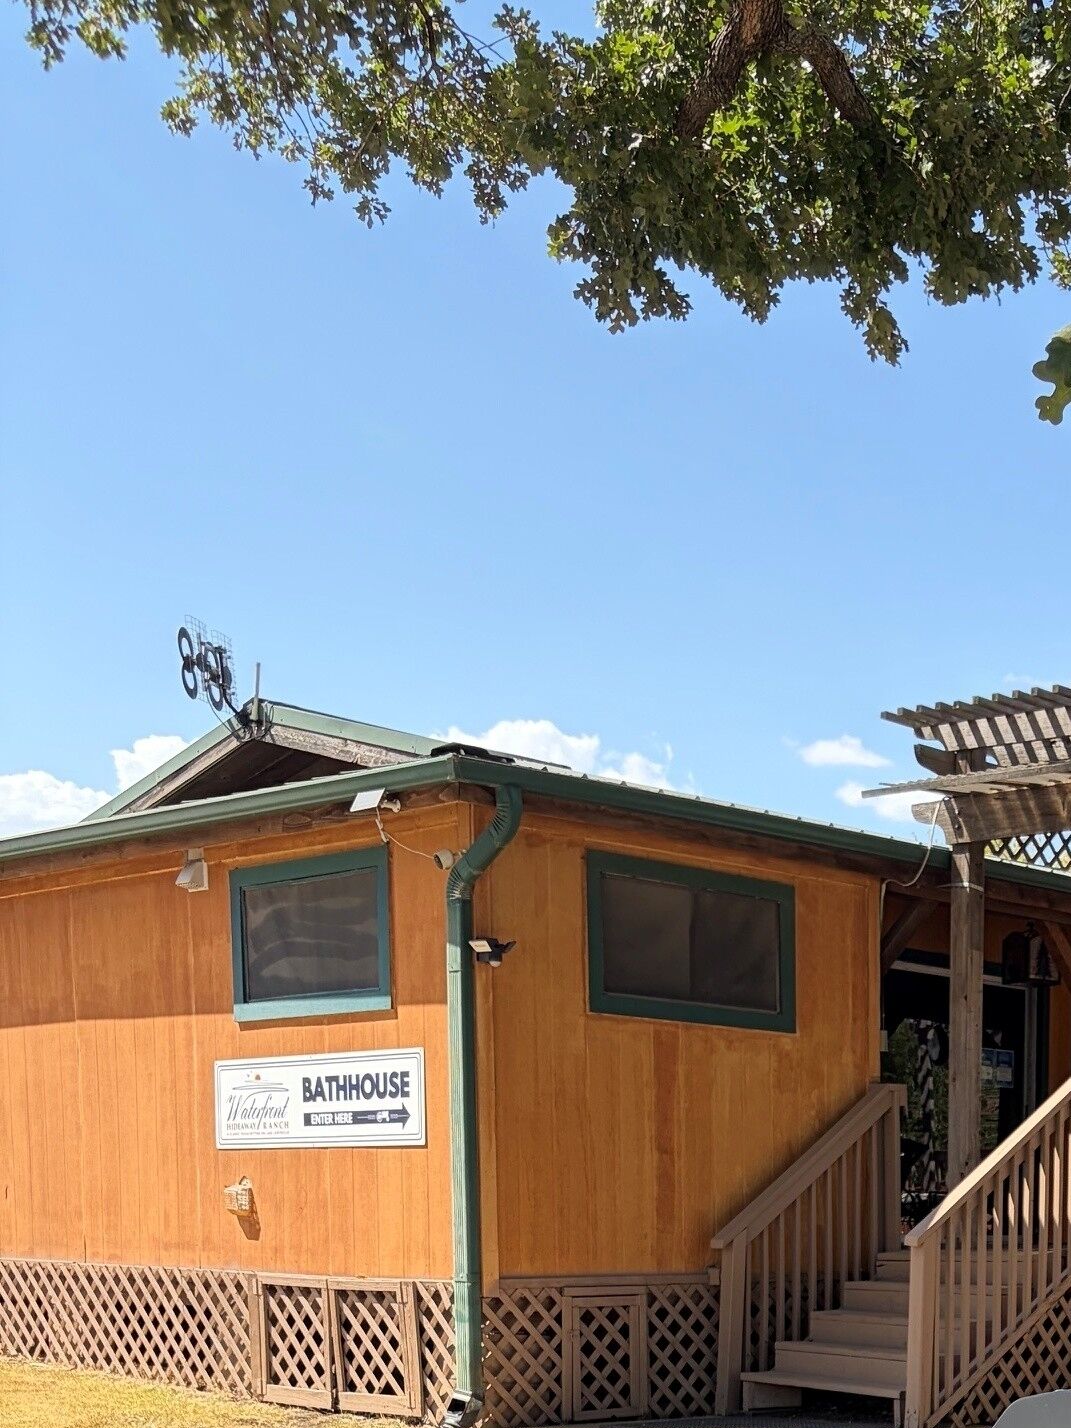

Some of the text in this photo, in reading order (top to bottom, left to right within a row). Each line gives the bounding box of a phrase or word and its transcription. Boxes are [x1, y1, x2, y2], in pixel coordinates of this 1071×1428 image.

[302, 1071, 410, 1103] BATHHOUSE
[226, 1091, 289, 1130] Waterfront
[310, 1112, 353, 1125] ENTER HERE
[226, 1120, 289, 1130] HIDEAWAY RANCH
